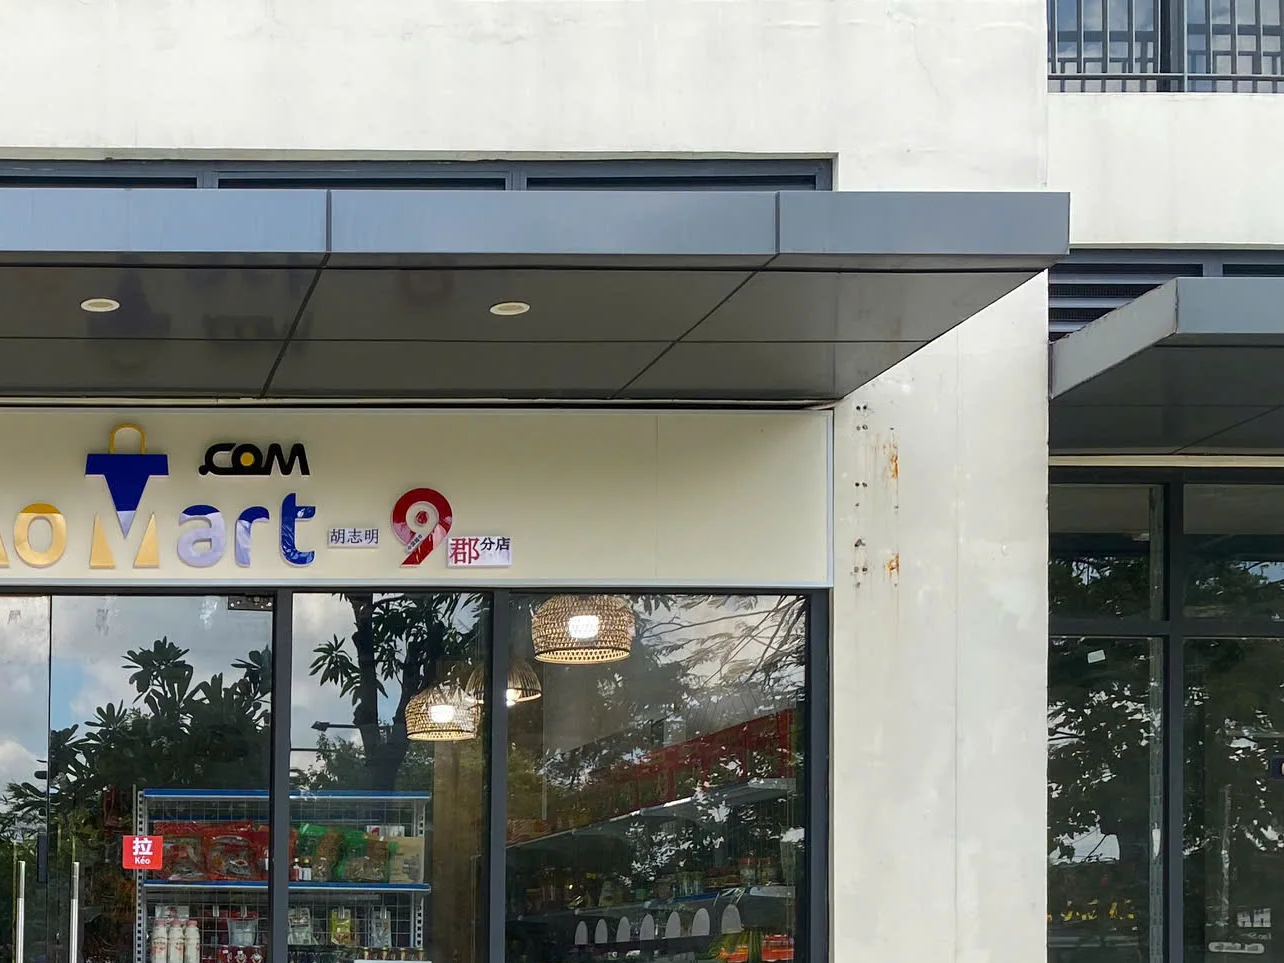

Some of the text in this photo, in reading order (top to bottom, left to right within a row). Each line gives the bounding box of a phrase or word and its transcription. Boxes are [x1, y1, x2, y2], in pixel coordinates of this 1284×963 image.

[330, 528, 379, 544] 胡志明
[132, 837, 154, 856] 拉
